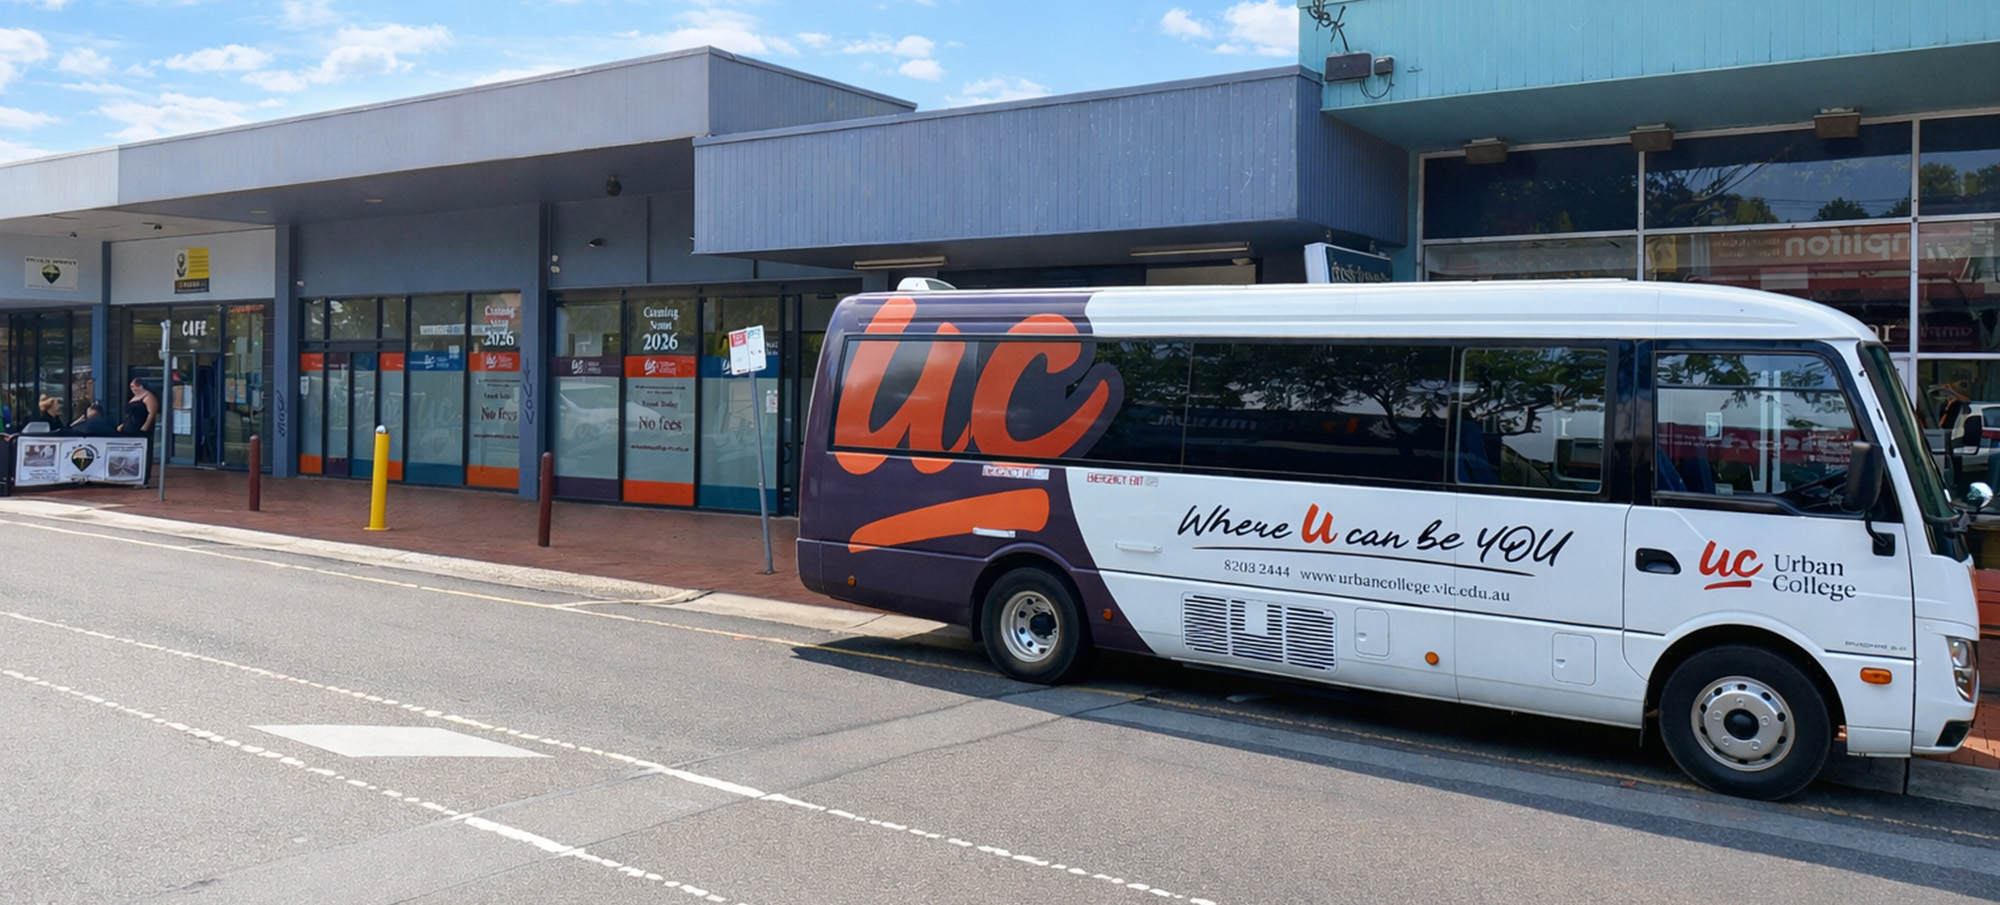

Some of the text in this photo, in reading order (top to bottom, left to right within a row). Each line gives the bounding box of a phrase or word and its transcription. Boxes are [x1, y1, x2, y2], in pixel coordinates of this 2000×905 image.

[182, 320, 208, 337] CAFE
[642, 332, 679, 351] 2026
[639, 416, 656, 430] No
[1177, 505, 1293, 539] Where
[1345, 527, 1409, 549] can
[1416, 519, 1464, 550] be
[1477, 525, 1574, 567] YOU
[1699, 540, 1764, 577] uc
[1773, 554, 1844, 576] Urban
[1259, 563, 1290, 577] 2444
[1299, 570, 1511, 602] www.urbancollege.vic.edu.au
[1772, 574, 1857, 602] College
